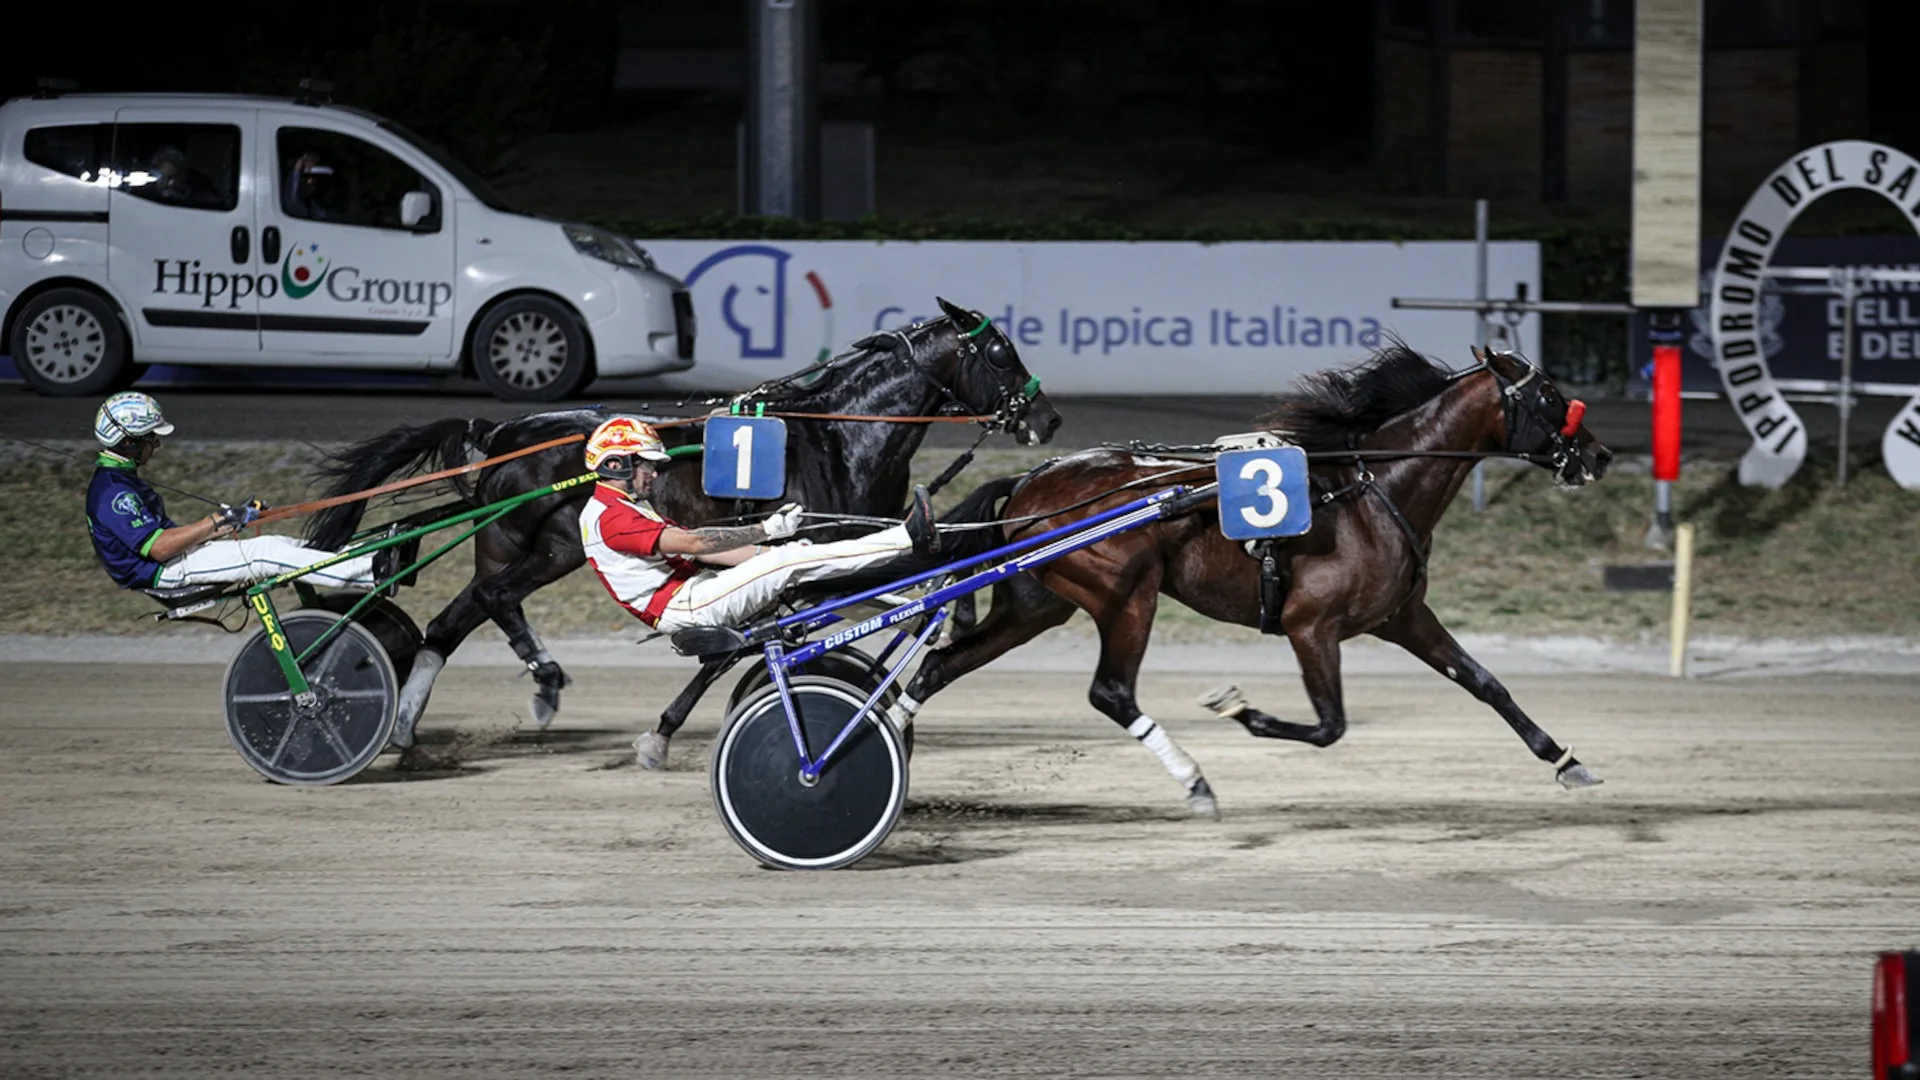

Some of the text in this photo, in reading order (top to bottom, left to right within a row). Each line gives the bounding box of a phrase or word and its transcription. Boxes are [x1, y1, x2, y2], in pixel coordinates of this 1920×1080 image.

[152, 258, 453, 318] Hippo Group
[1720, 220, 1799, 454] IPPODROMO
[1769, 148, 1845, 208] DEL
[1864, 150, 1920, 218] SA
[1059, 307, 1194, 355] Ippica
[1209, 304, 1382, 348] Italiana
[551, 477, 577, 491] UFO
[732, 424, 754, 490] 1
[1239, 457, 1289, 529] 3
[252, 593, 285, 652] UFO
[824, 601, 926, 649] CUSTOM FLEXURE
